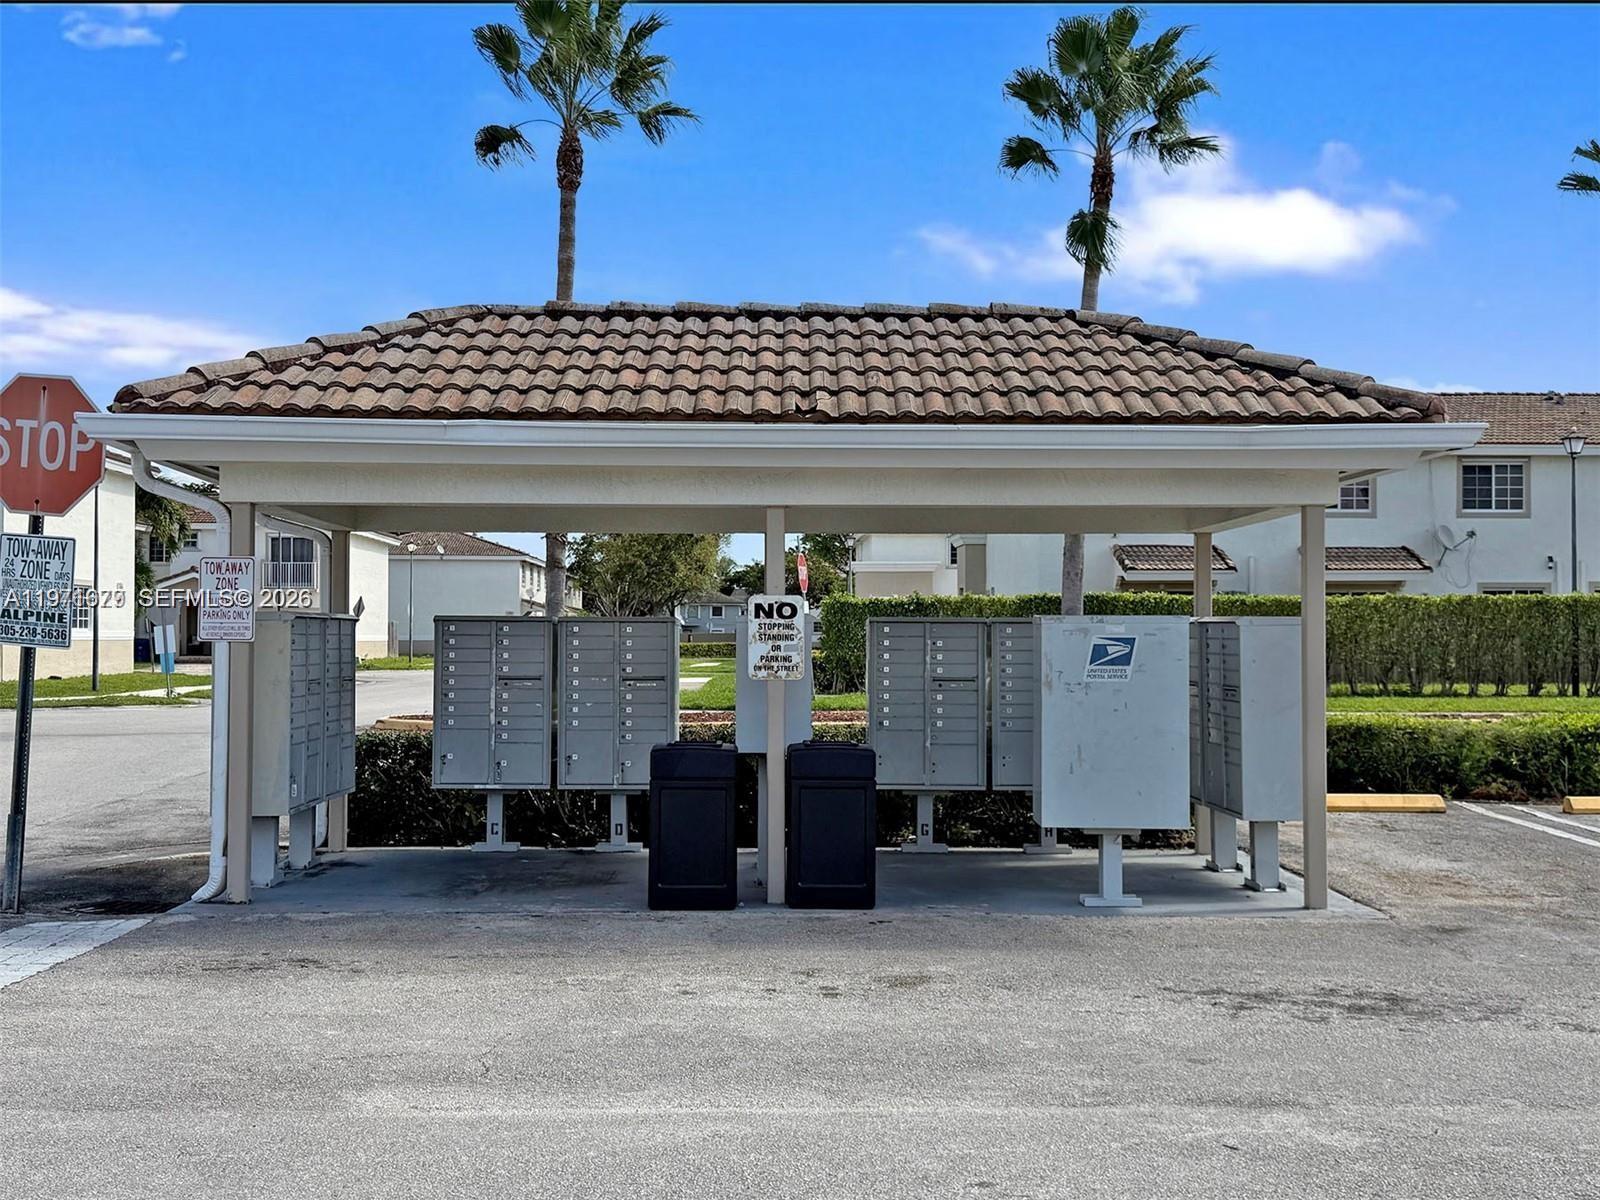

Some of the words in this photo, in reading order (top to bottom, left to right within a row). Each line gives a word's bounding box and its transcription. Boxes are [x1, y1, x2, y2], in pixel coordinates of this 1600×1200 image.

[6, 537, 68, 561] TOW-AWAY
[4, 557, 15, 568] 24
[60, 561, 66, 572] 7
[1, 567, 16, 578] HRS
[20, 559, 51, 580] ZONE
[54, 571, 71, 582] DAYS
[215, 577, 239, 591] ZONE
[0, 608, 68, 624] ALPINE
[202, 610, 232, 620] PARKING
[232, 610, 251, 620] ONLY
[754, 602, 798, 620] NO
[757, 622, 796, 631] STOPPING
[0, 624, 68, 641] 305-238-5636
[757, 633, 795, 642] STANDING
[771, 644, 782, 653] OR
[760, 655, 793, 663] PARKING
[491, 823, 499, 836] C
[921, 823, 929, 836] G
